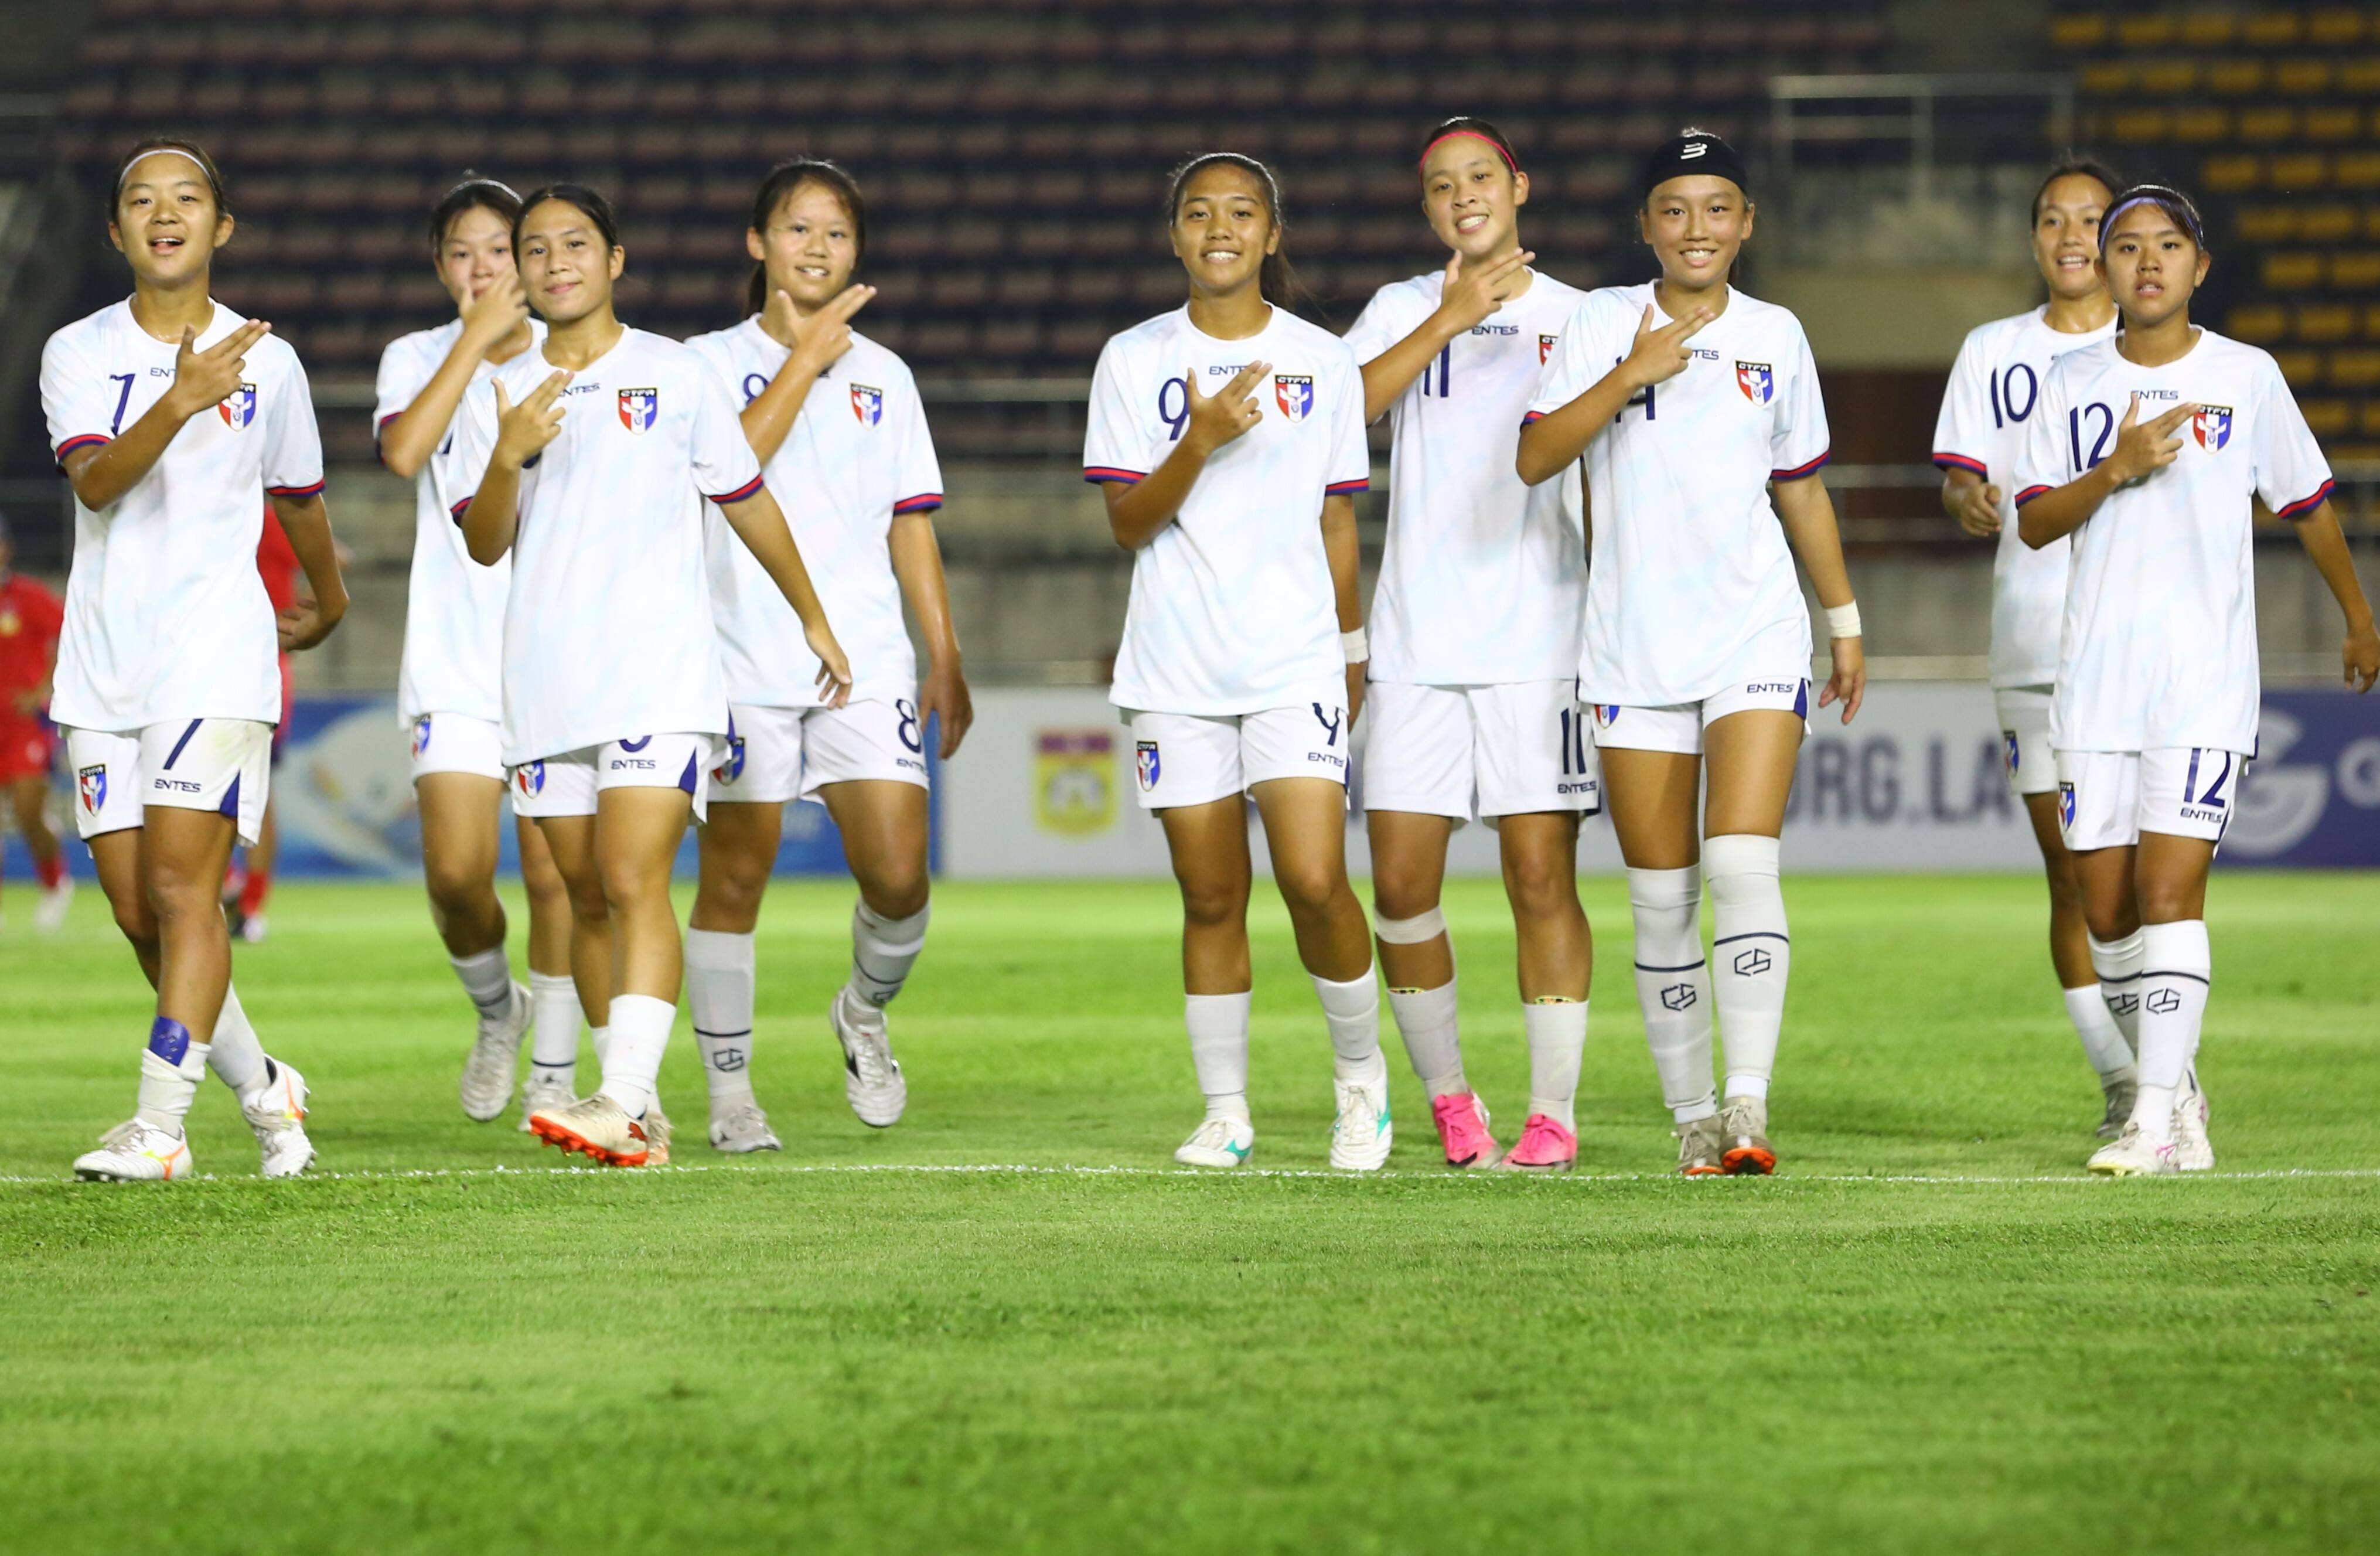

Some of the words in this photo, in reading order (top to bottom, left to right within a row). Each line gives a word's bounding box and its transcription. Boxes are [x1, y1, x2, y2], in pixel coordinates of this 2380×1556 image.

[1471, 326, 1519, 336] ENTES
[1158, 377, 1191, 442] 9
[1990, 363, 2038, 429] 10
[2069, 401, 2114, 472] 12
[1747, 683, 1795, 693] ENTES
[895, 697, 923, 754] 8
[1560, 707, 1587, 775] 11
[154, 778, 203, 792] ENTES
[611, 759, 656, 770] ENTES
[1557, 780, 1598, 794] ENTES
[2183, 747, 2232, 809] 12
